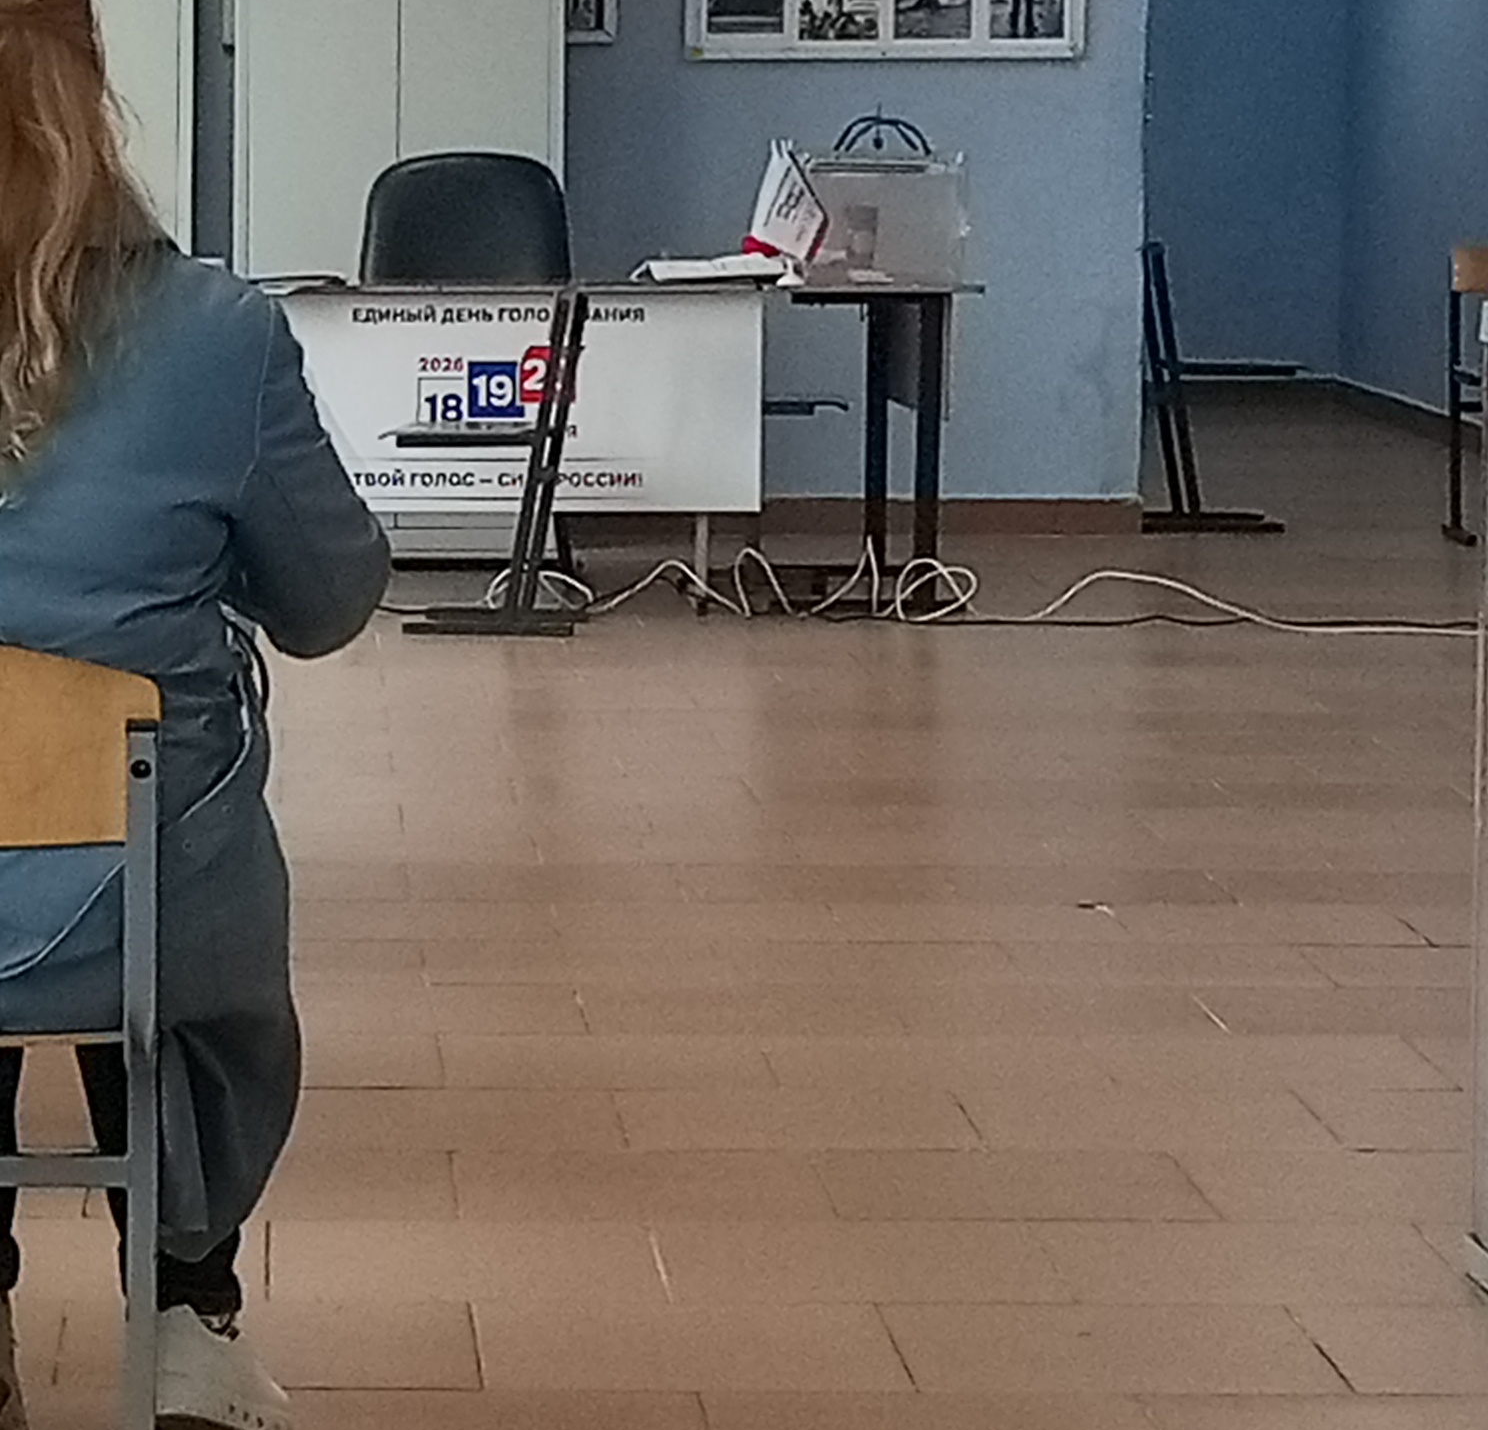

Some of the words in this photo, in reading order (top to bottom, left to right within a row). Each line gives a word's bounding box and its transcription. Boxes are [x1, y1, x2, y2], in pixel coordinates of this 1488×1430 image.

[352, 304, 437, 325] ЕДИНЫЙ
[440, 307, 493, 325] ДЕНЬ
[498, 307, 645, 323] ГОЛОАНИЯ
[418, 357, 463, 372] 2026
[424, 393, 463, 422] 18
[472, 374, 513, 407] 19
[522, 359, 548, 391] 2
[353, 469, 404, 487] ТВОЙ
[409, 472, 475, 487] ГОЛОС
